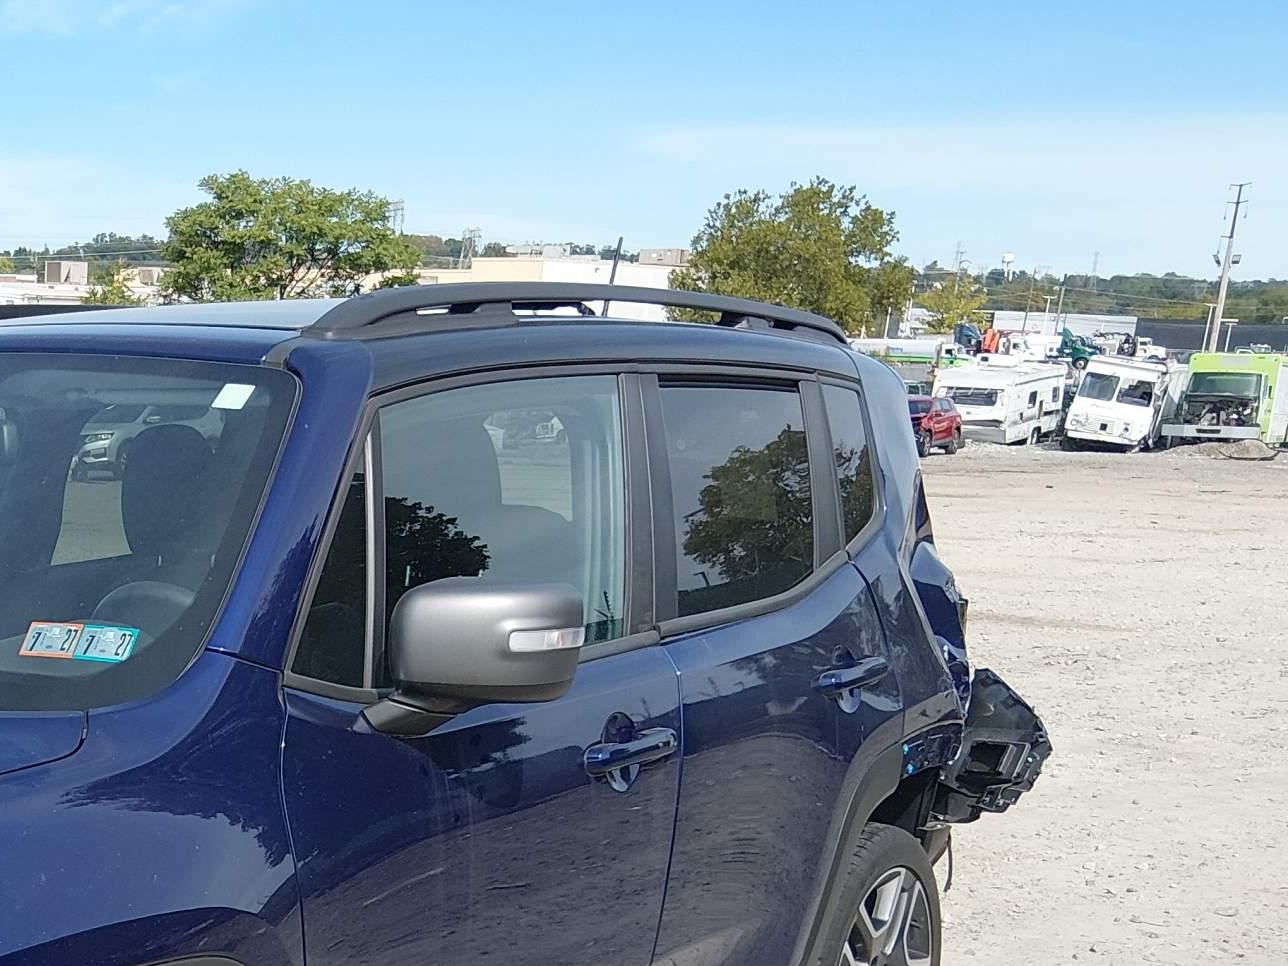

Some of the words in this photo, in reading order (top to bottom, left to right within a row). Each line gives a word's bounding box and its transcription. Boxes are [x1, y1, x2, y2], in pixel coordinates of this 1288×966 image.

[29, 631, 41, 652] 7
[60, 628, 79, 653] 27
[83, 634, 96, 656] 7
[114, 632, 134, 657] 27
